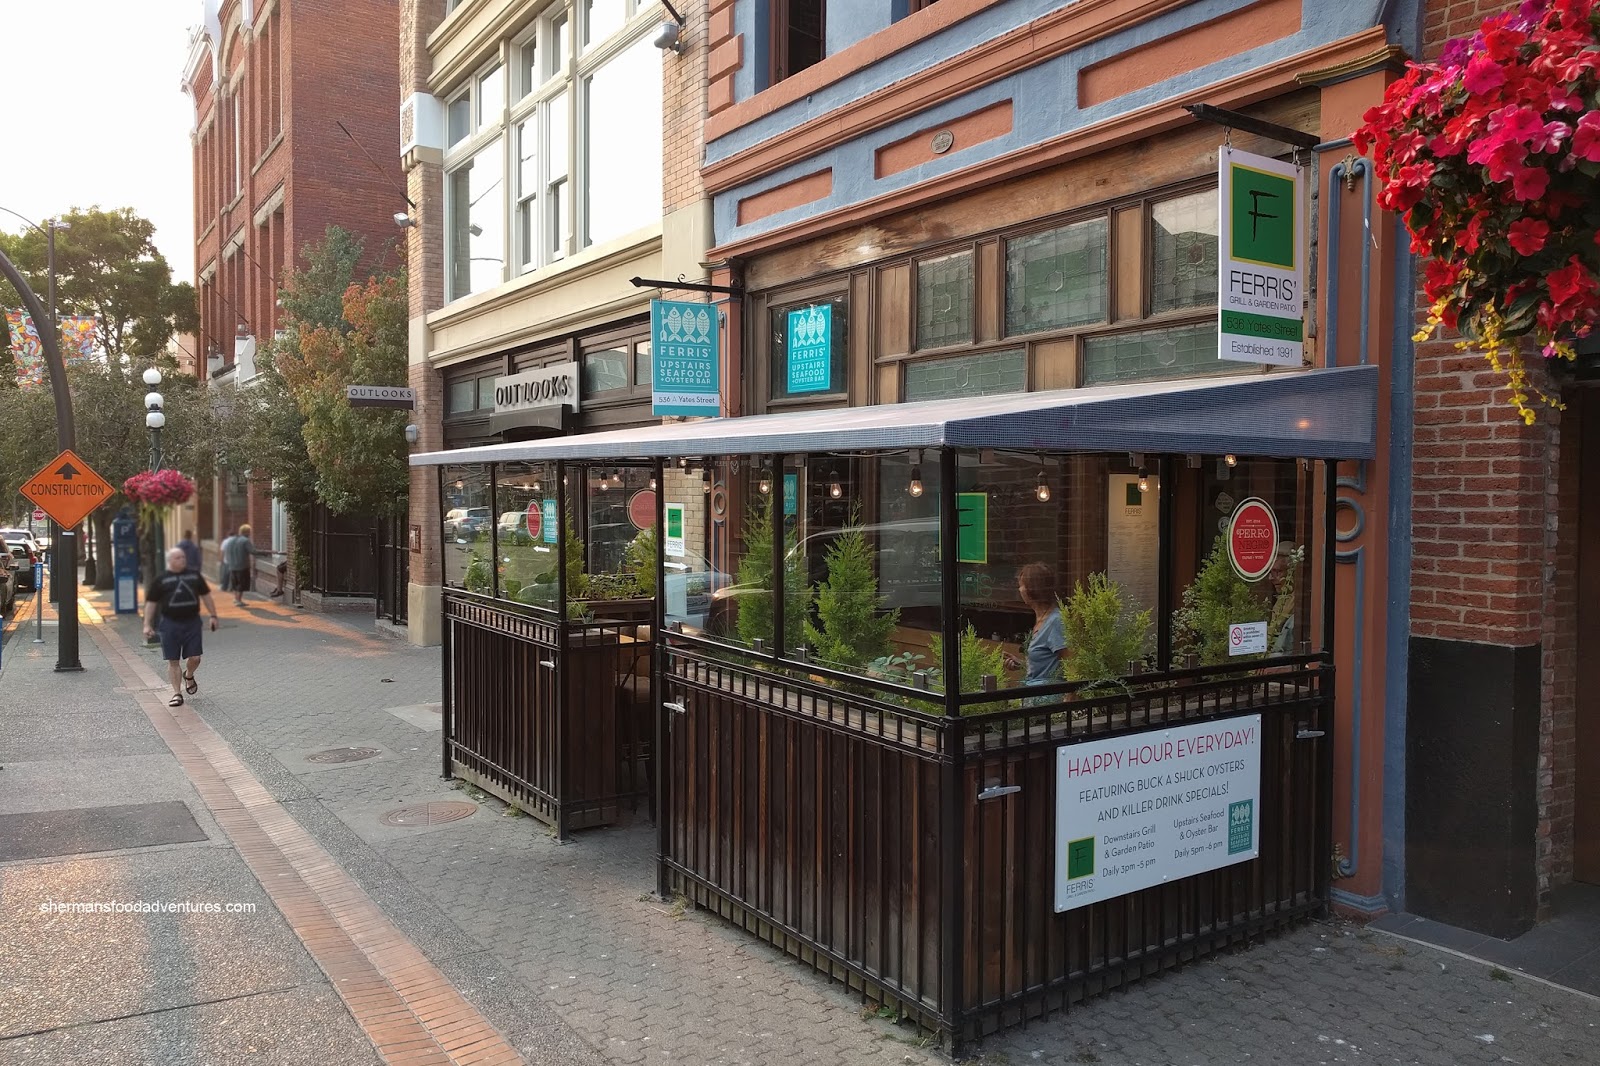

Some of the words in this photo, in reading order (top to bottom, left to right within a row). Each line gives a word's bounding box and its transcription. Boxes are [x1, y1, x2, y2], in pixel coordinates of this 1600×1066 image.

[1230, 270, 1296, 300] FERRIS'
[1230, 296, 1246, 306] GRILL
[1248, 298, 1253, 306] &
[1253, 300, 1279, 310] GARDEN
[1280, 304, 1296, 313] PATIO
[1226, 316, 1245, 330] 536
[1248, 320, 1272, 334] Yates
[1274, 322, 1298, 337] Street
[660, 346, 711, 358] FERRIS'
[792, 347, 826, 360] FERRIS'
[1231, 340, 1274, 356] Established
[1277, 347, 1293, 358] 1991
[660, 361, 711, 370] UPSTAIRS
[660, 369, 710, 378] SEAFOOD
[792, 361, 824, 371] UPSTAIRS
[792, 369, 825, 379] SEAFOOD
[350, 388, 412, 398] OUTLOOKS
[496, 374, 569, 406] OUTLOOKS
[31, 483, 105, 496] CONSTRUCTION
[1236, 528, 1270, 539] PERRO
[1239, 540, 1269, 550] NEGRO
[1068, 750, 1124, 778] HAPPY
[1128, 742, 1173, 767] HOUR
[1177, 727, 1254, 758] EVERYDAY!
[1079, 781, 1135, 803] FEATURING
[1137, 775, 1163, 791] BUCK
[1165, 774, 1172, 785] A
[1174, 767, 1205, 784] SHUCK
[1207, 759, 1245, 777] OYSTERS
[1097, 807, 1119, 823] AND
[1122, 799, 1153, 817] KILLER
[1156, 793, 1183, 810] DRINK
[1185, 780, 1229, 802] SPECIALS!
[1173, 816, 1199, 829] Upstairs
[1200, 808, 1224, 822] Seafood
[1103, 830, 1140, 845] Downstairs
[1142, 824, 1156, 836] Grill
[1180, 831, 1184, 841] &
[1186, 828, 1206, 839] Oyster
[1207, 824, 1218, 834] Bar
[1104, 850, 1110, 859] &
[1111, 844, 1137, 857] Garden
[1138, 840, 1155, 850] Patio
[1174, 847, 1190, 859] Daily
[1190, 846, 1204, 856] 5pm
[1213, 841, 1223, 850] pm
[1102, 865, 1120, 878] Daily
[1121, 864, 1135, 875] 3pm
[1145, 858, 1156, 868] pm
[1066, 878, 1095, 894] FERRIS'
